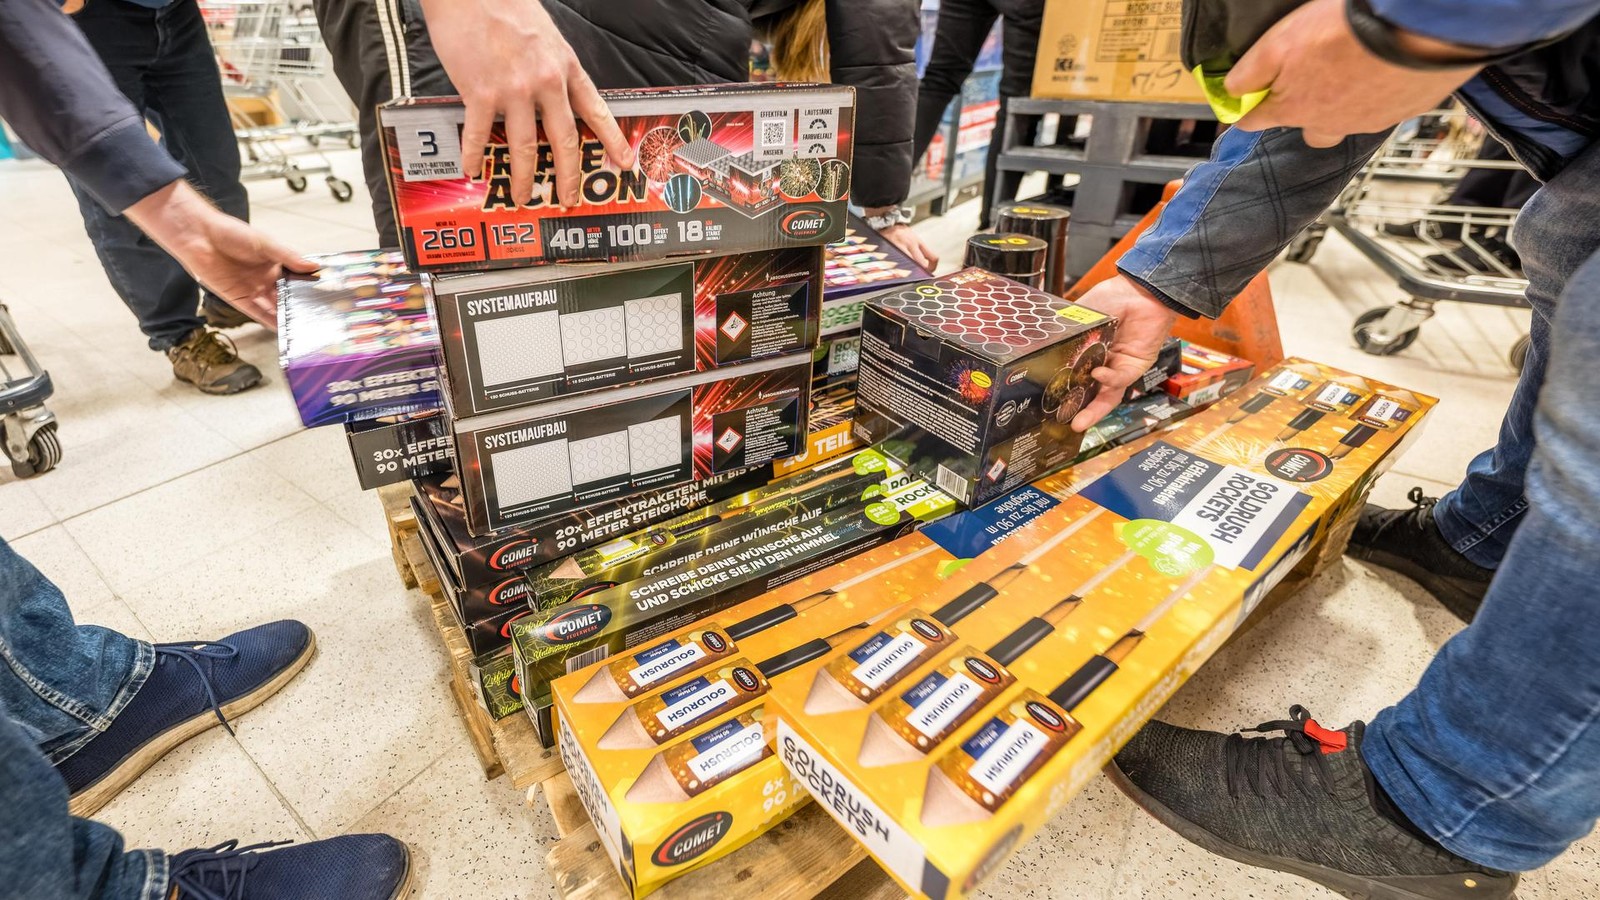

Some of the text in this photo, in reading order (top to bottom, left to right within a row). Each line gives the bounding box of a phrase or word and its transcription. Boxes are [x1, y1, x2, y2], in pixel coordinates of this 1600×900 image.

[760, 110, 788, 118] EFFEKTFILM
[417, 131, 438, 157] 3
[802, 132, 833, 141] FARBVIELFALT
[408, 168, 433, 176] KOMPLETT
[409, 161, 456, 169] EFFEKT-BATTERIEN
[491, 223, 535, 246] 152
[607, 223, 652, 247] 100
[677, 220, 704, 243] 18
[791, 218, 826, 231] COMET
[422, 227, 476, 251] 260
[550, 228, 585, 250] 40
[466, 289, 558, 317] SYSTEMAUFBAU
[752, 290, 776, 299] Achtung
[746, 406, 768, 415] Achtung
[484, 420, 567, 450] SYSTEMAUFBAU
[373, 447, 404, 463] 30x
[376, 460, 399, 474] 90
[1138, 445, 1176, 472] Steighöhe
[1278, 453, 1312, 478] COMET
[1140, 452, 1190, 493] mit bis zu 90 m
[1152, 462, 1206, 506] Effektraketen
[555, 524, 583, 540] 20x
[586, 482, 699, 532] EFFEKTRAKETEN
[702, 472, 724, 488] MIT
[994, 489, 1040, 515] Steighöhe
[1196, 473, 1248, 523] ROCKETS
[556, 490, 707, 551] 90 METER STEIGHÖHE
[801, 508, 822, 522] AUF
[984, 496, 1051, 536] mit bis zu 90 m
[1210, 481, 1280, 545] GOLDRUSH
[501, 544, 539, 565] COMET
[505, 557, 532, 570] FEUERWERK
[629, 525, 824, 599] SCHREIBE DEINE WÜNSCHE AUF
[636, 532, 840, 611] UND SCHICKE SIE IN DEN HIMMEL
[559, 611, 602, 636] COMET
[566, 625, 598, 640] FEUERWERK
[706, 633, 722, 648] COMET
[639, 649, 696, 679] GOLDRUSH
[865, 640, 914, 680] GOLDRUSH
[738, 669, 756, 688] COMET
[667, 687, 727, 723] GOLDRUSH
[921, 682, 970, 727] GOLDRUSH
[709, 733, 722, 743] Meter
[700, 732, 762, 772] GOLDRUSH
[984, 730, 1034, 781] GOLDRUSH
[763, 777, 784, 796] 6x
[783, 735, 890, 843] GOLDRUSH
[783, 747, 868, 838] ROCKETS
[763, 790, 787, 813] 90
[673, 819, 725, 859] COMET
